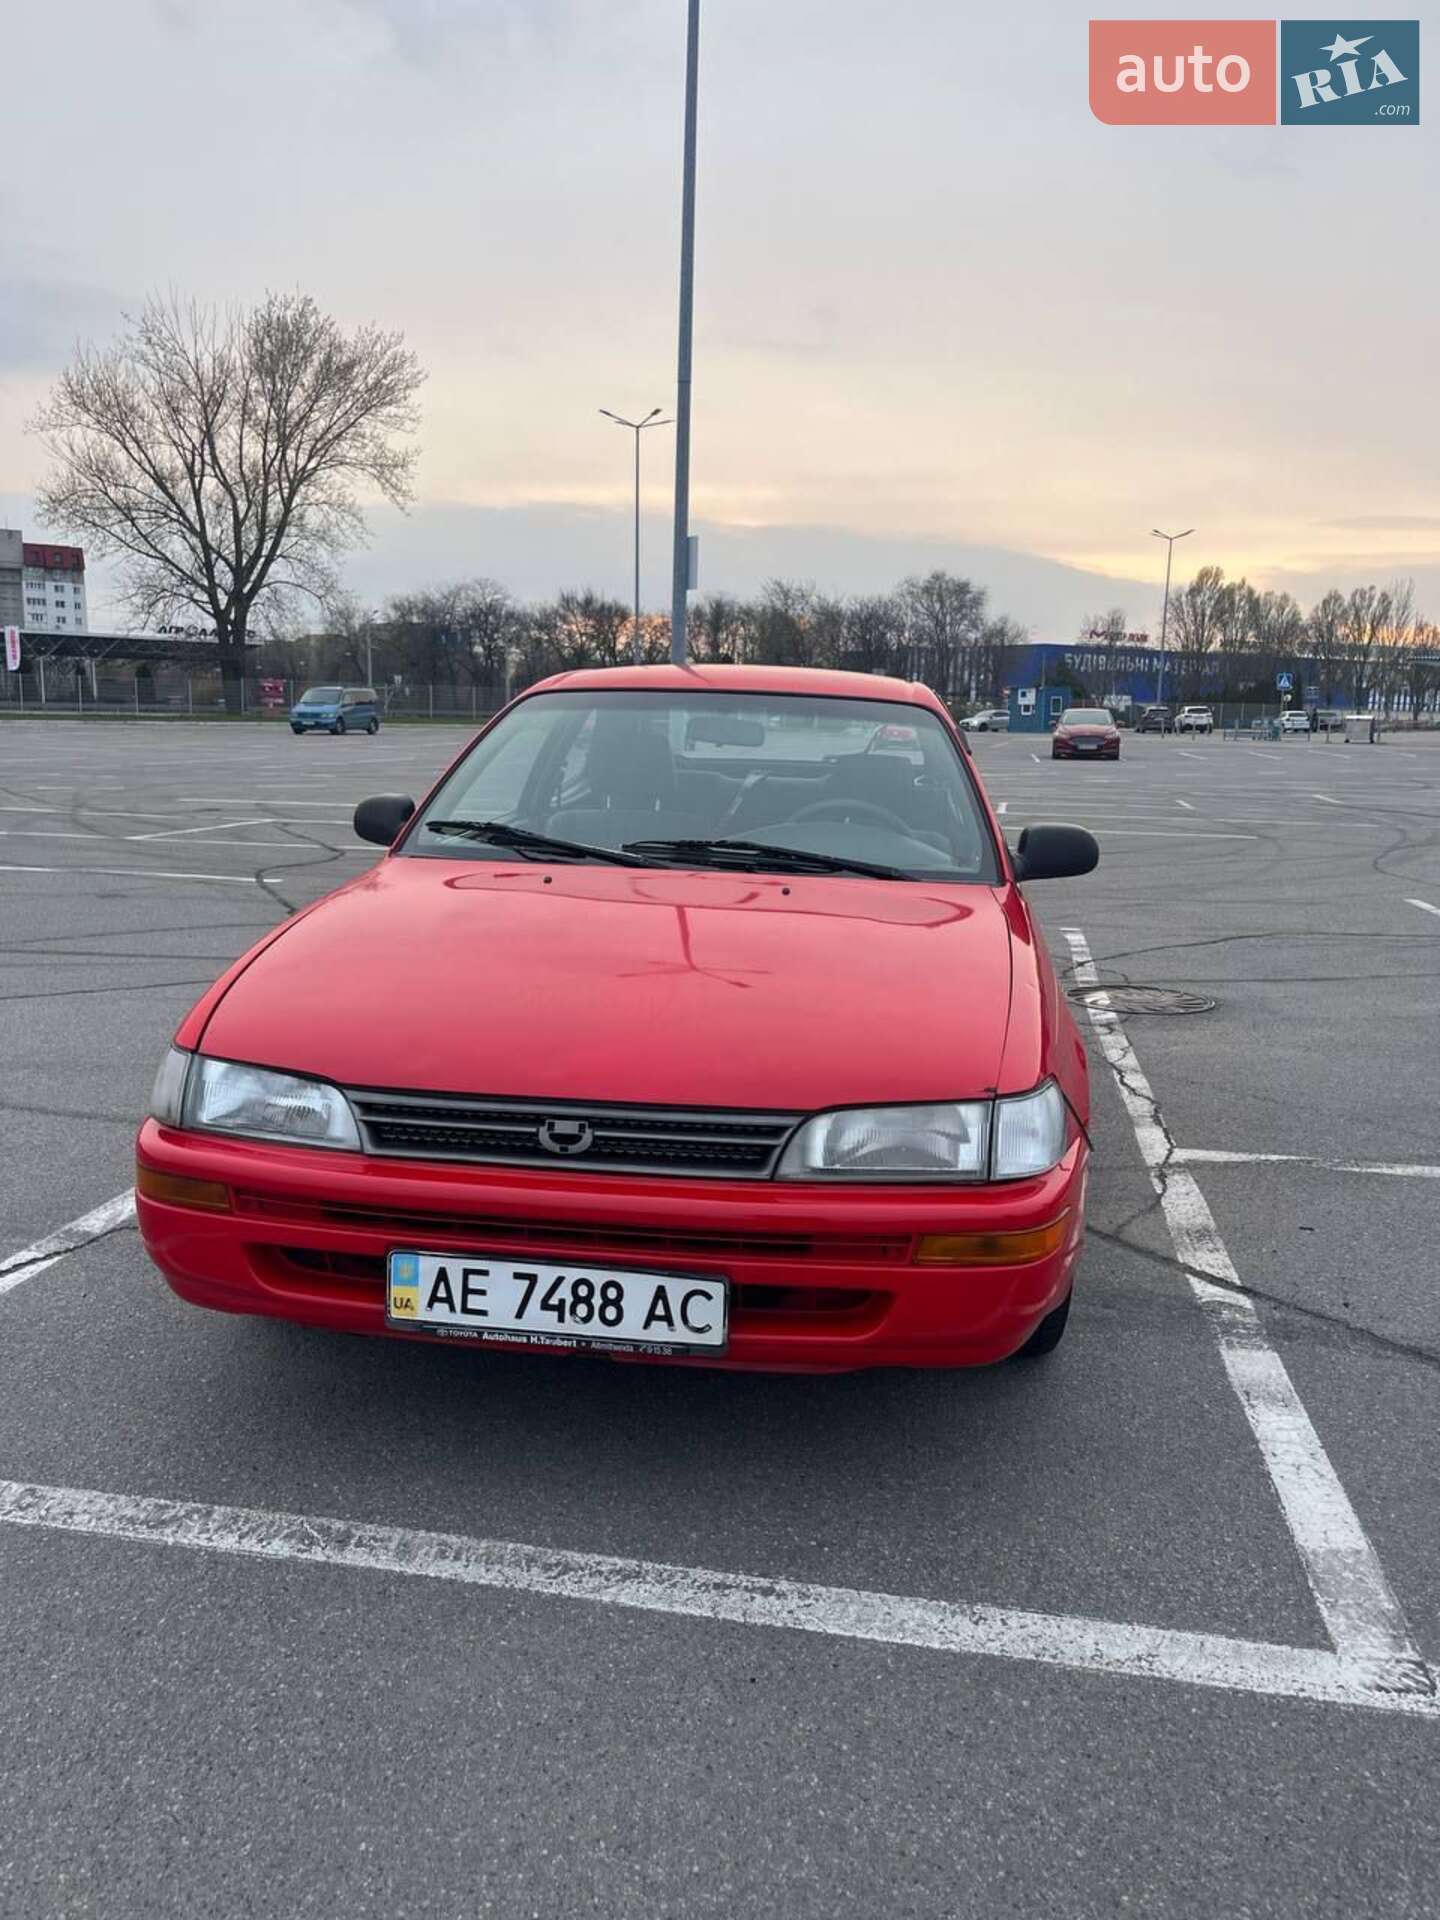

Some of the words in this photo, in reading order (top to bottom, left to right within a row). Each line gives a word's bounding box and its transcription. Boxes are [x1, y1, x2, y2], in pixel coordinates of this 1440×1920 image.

[393, 1297, 415, 1311] UA
[425, 1266, 489, 1317] AE
[511, 1271, 624, 1328] 7488
[642, 1284, 714, 1334] AC
[448, 1329, 478, 1339] TOYOTA
[482, 1331, 528, 1344] Autohaus
